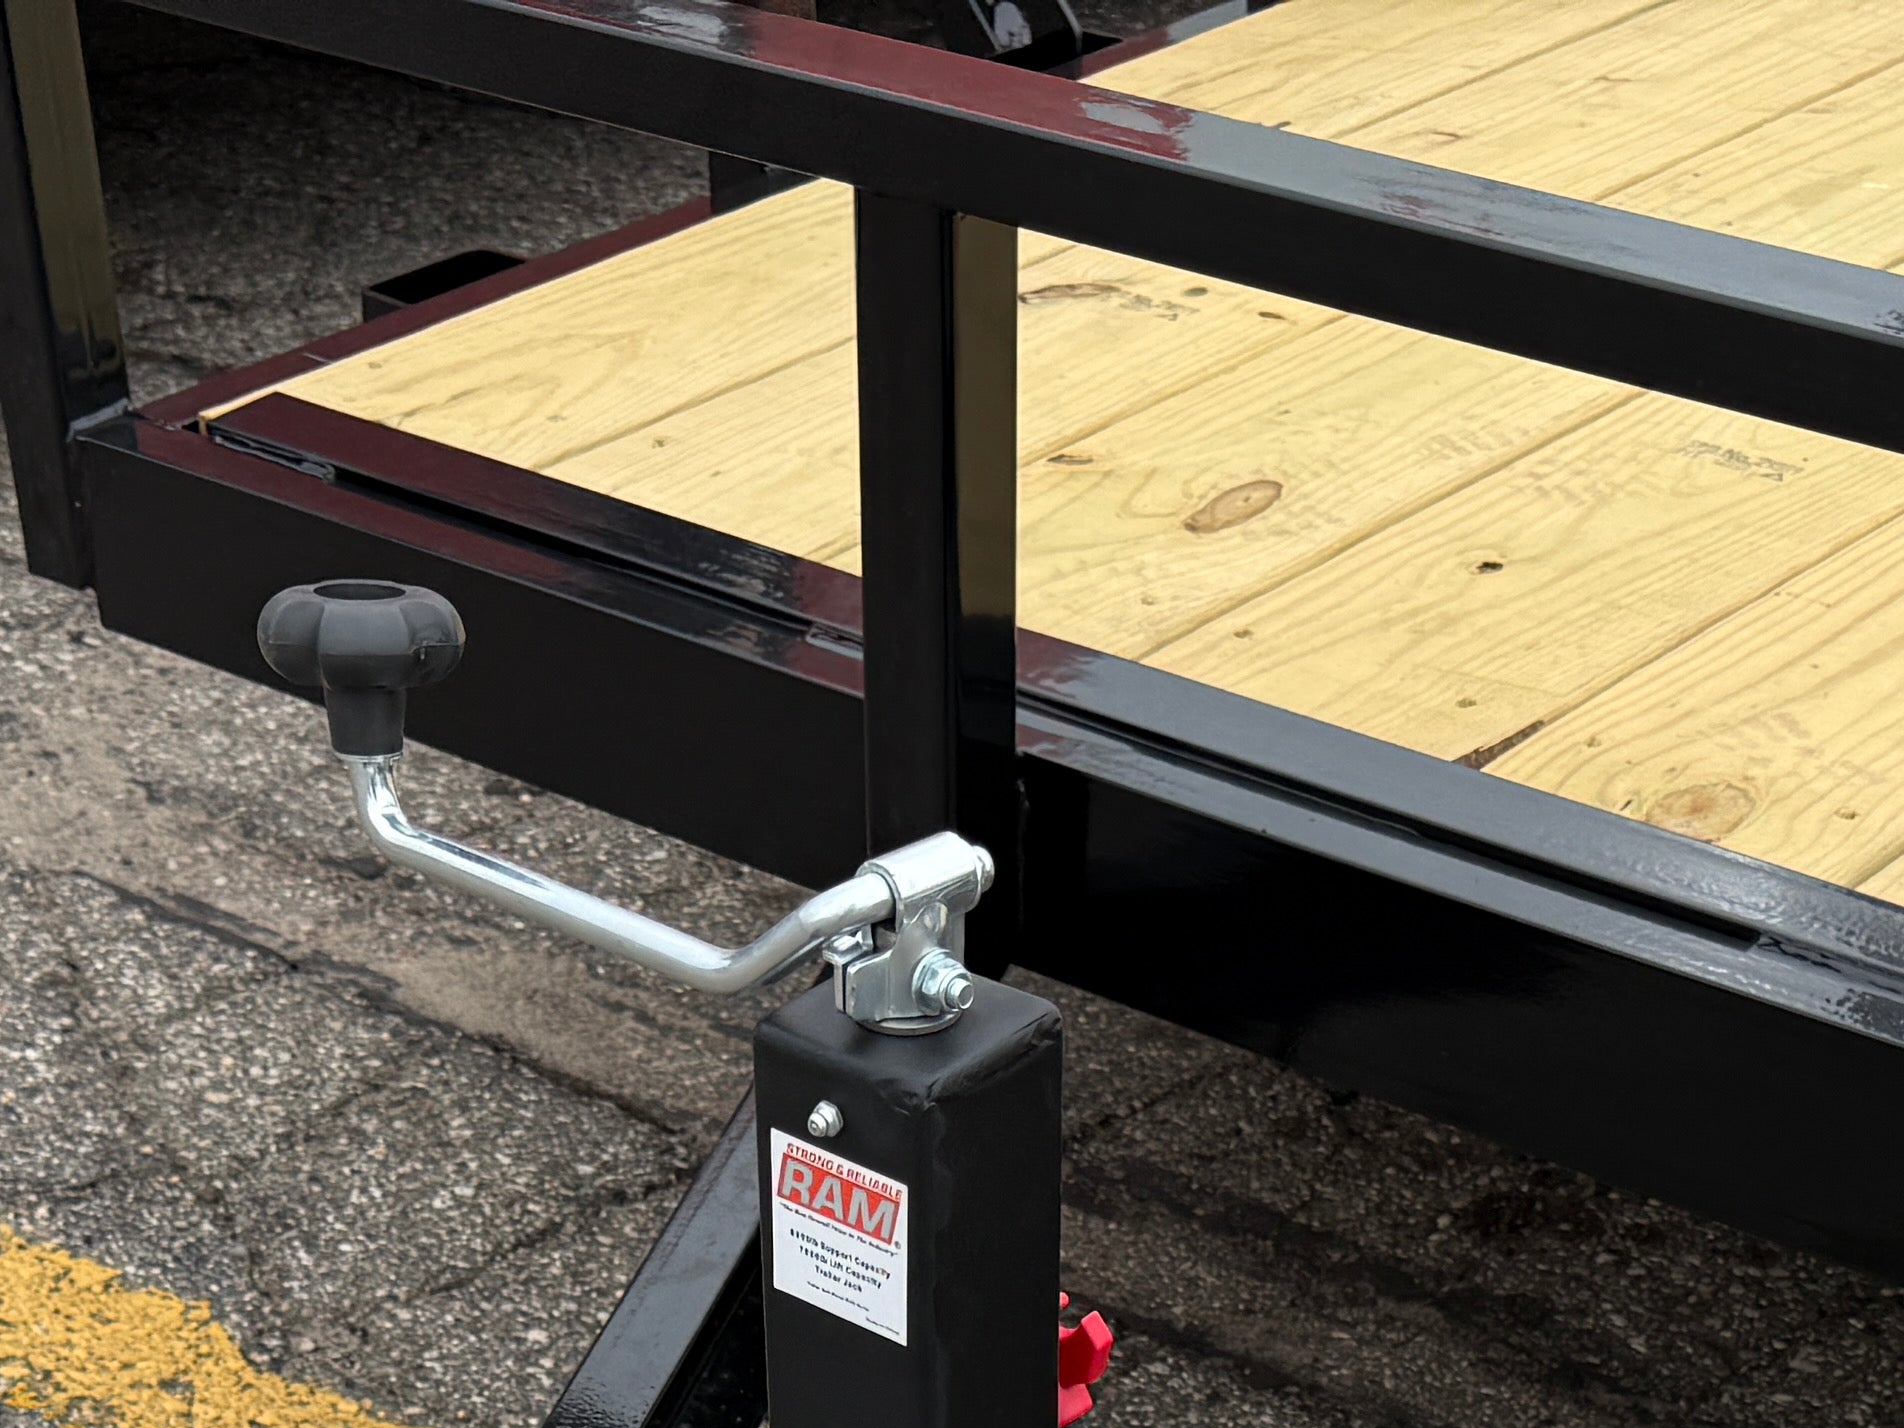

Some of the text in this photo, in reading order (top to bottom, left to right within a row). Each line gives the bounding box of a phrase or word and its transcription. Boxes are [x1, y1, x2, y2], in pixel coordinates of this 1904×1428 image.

[780, 1154, 895, 1244] RAM
[786, 1141, 902, 1201] STRONG & RELIABLE
